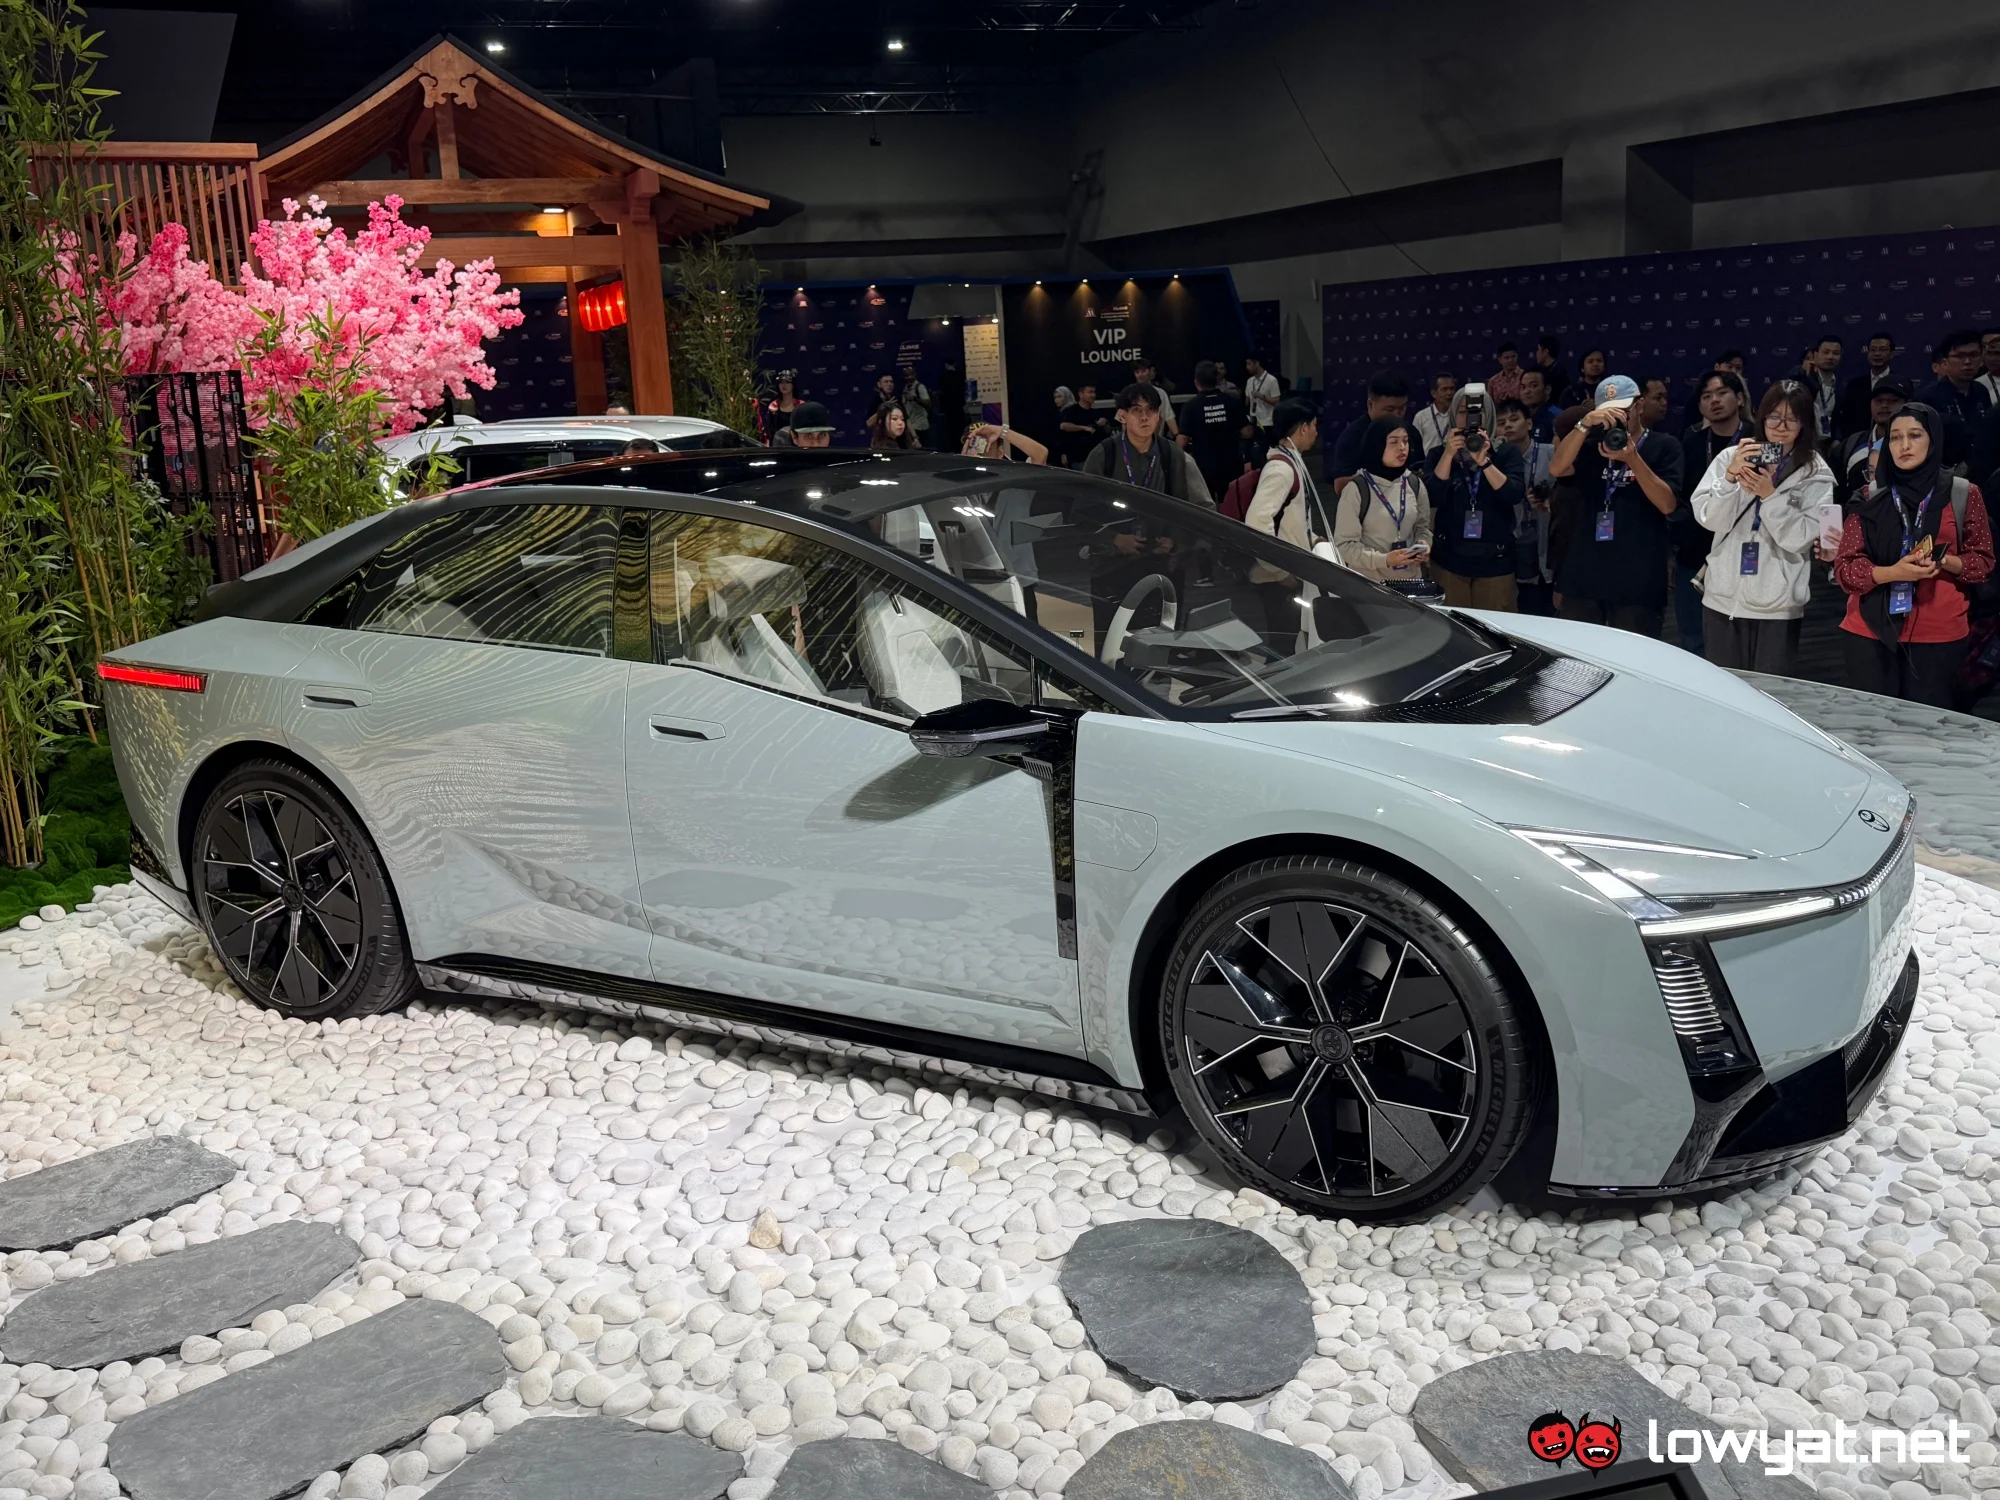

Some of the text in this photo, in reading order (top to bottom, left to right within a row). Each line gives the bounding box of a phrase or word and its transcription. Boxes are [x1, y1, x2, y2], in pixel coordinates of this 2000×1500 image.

[1093, 328, 1127, 345] VIP
[1080, 348, 1142, 364] LOUNGE
[1203, 404, 1225, 412] BECAUSE
[1205, 416, 1227, 424] MATTERS
[1163, 948, 1186, 1043] MICHELIN
[1186, 923, 1203, 946] PILOT
[1202, 903, 1224, 924] SPORT
[1474, 1057, 1505, 1157] MICHELIN
